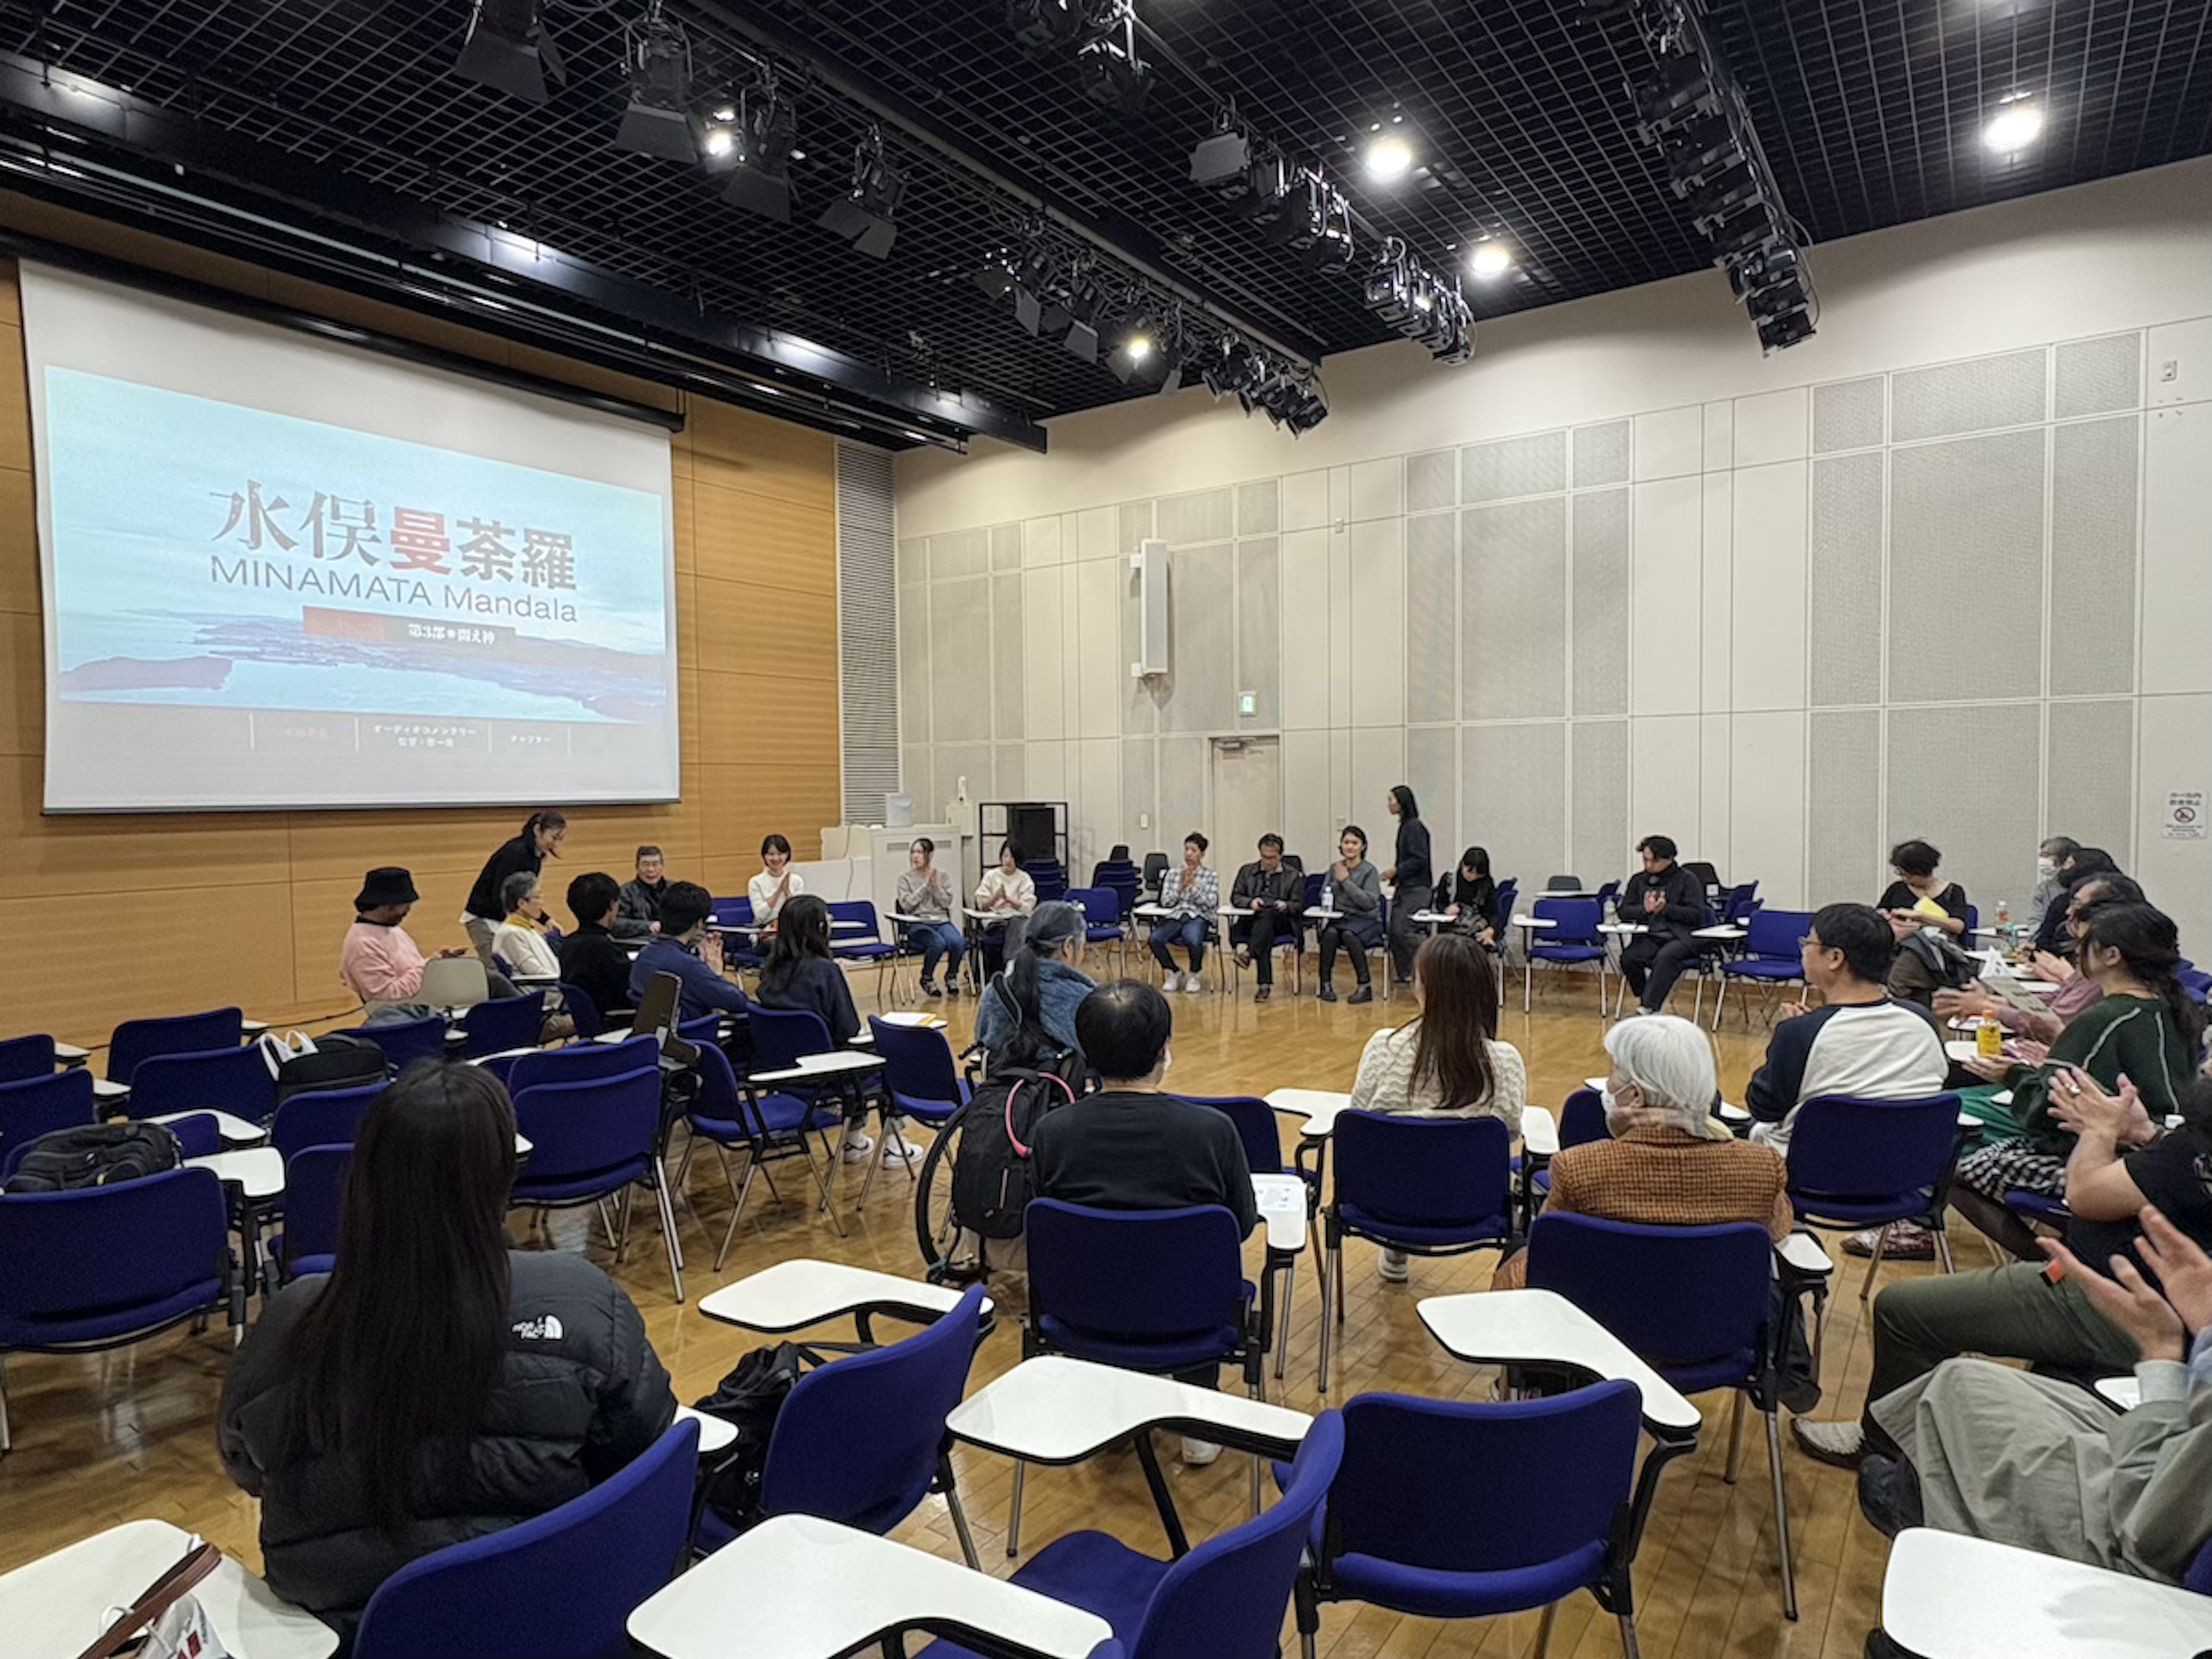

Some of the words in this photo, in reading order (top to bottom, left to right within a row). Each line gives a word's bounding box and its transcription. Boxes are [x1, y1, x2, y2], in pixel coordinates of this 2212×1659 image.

[210, 479, 577, 590] 水俣曼荼羅
[211, 555, 431, 606] MINAMATA
[444, 585, 577, 622] Mandala
